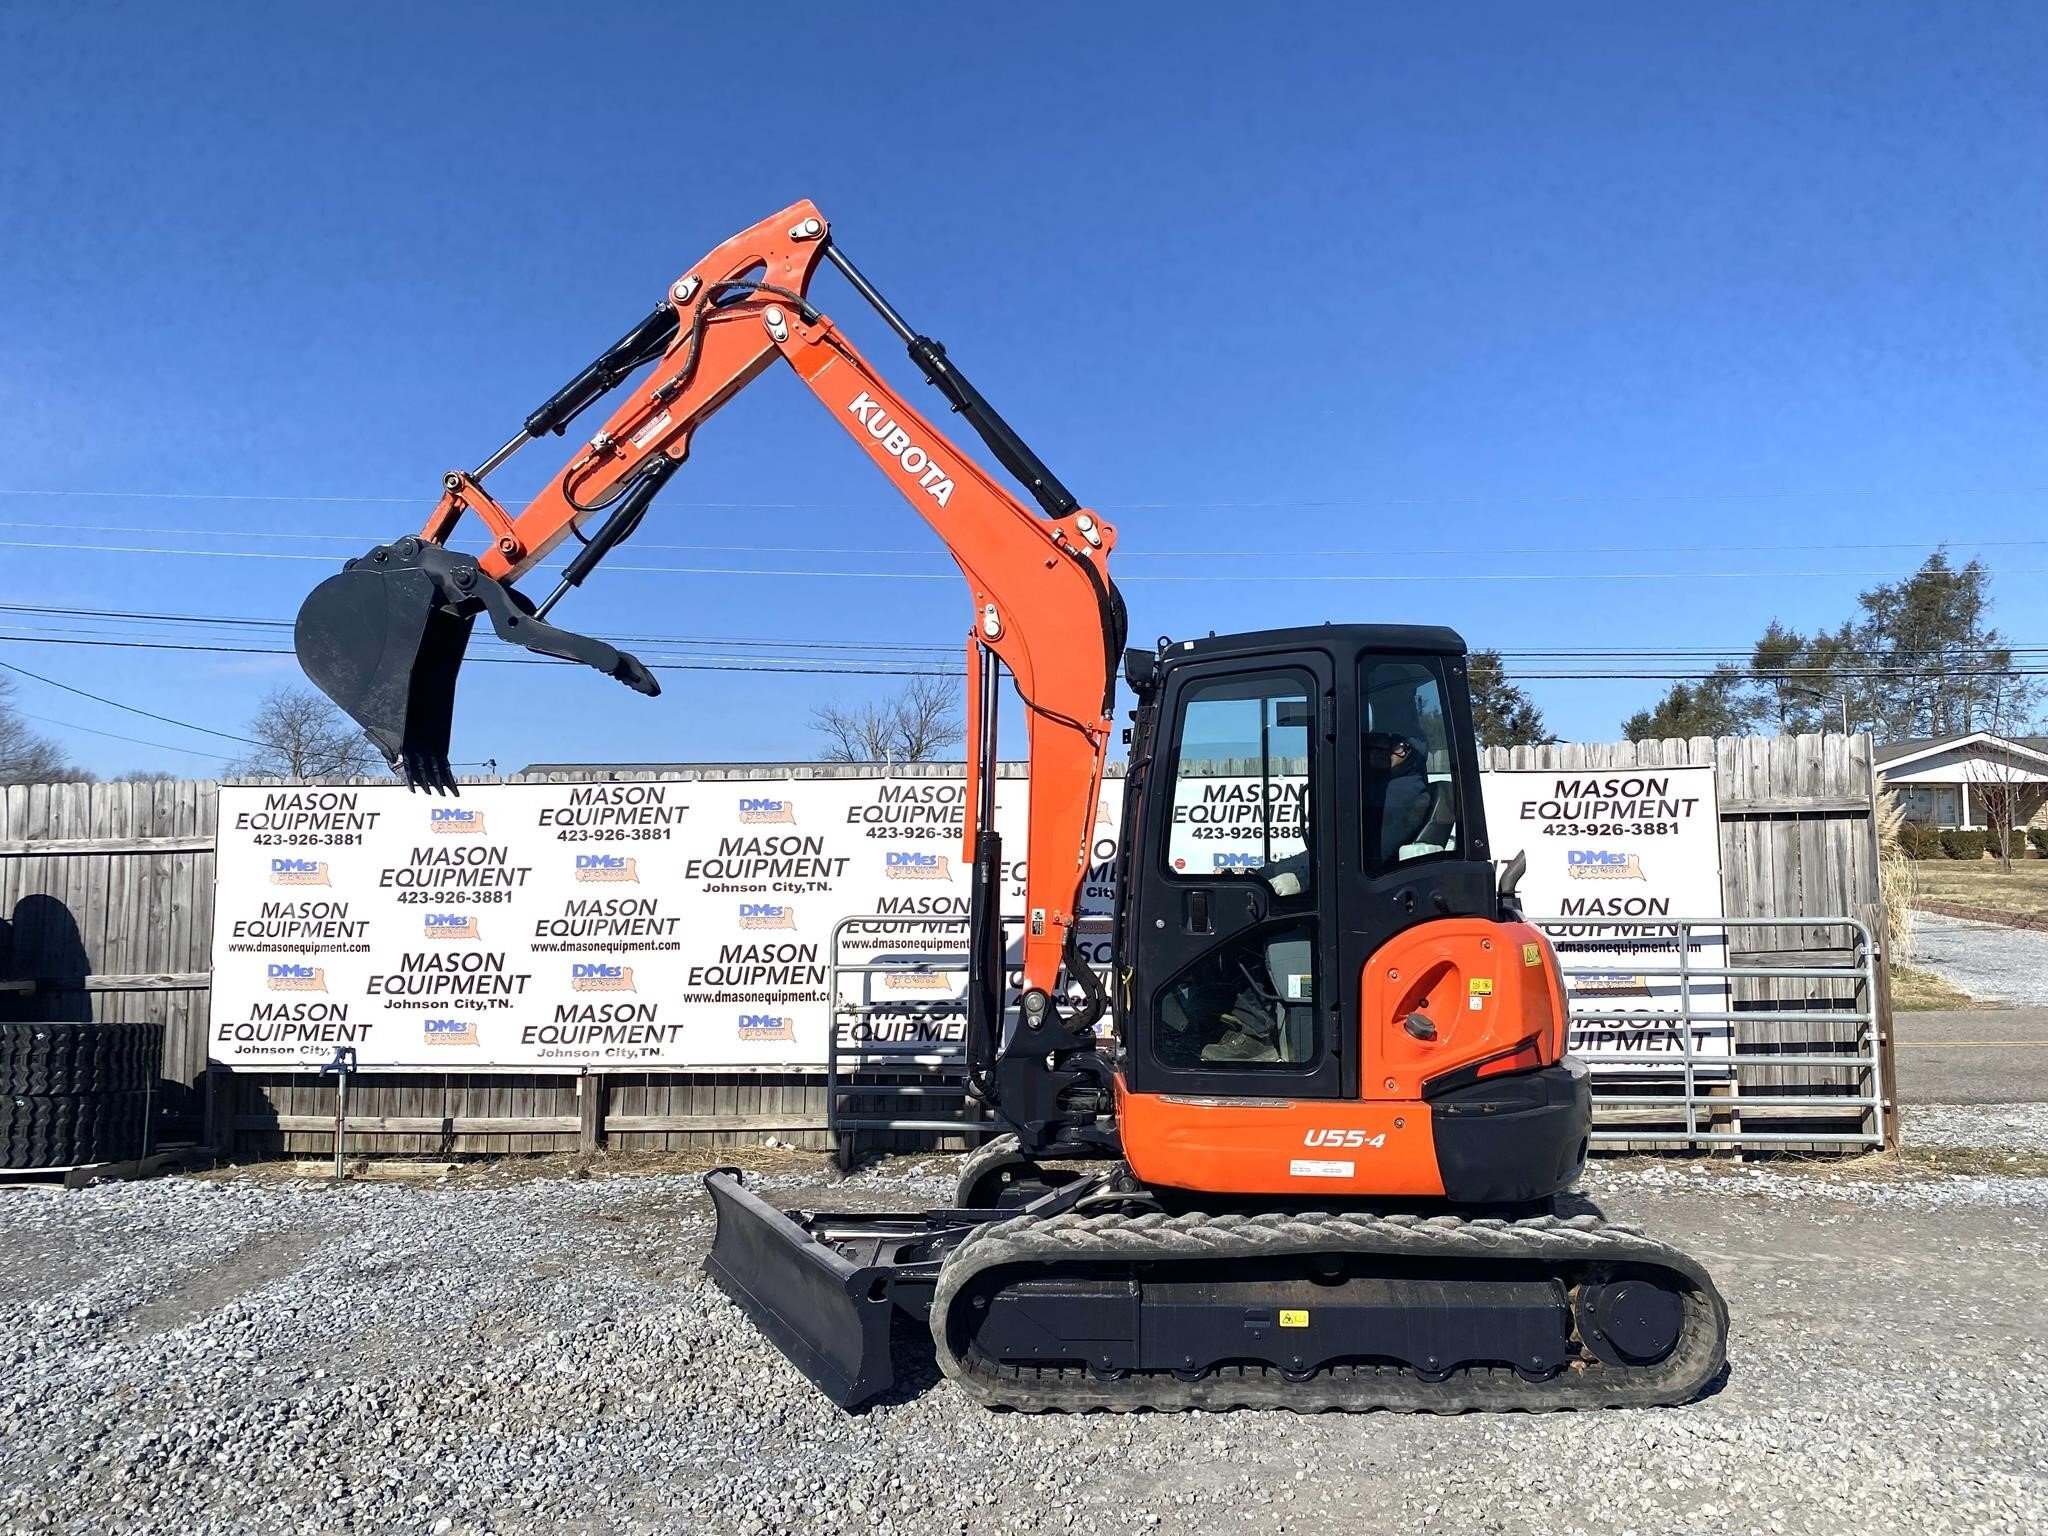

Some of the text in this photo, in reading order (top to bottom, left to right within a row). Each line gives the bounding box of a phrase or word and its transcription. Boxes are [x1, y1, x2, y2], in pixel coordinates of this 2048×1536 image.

[848, 390, 955, 508] KUBOTA
[570, 785, 666, 805] MASON
[1555, 778, 1669, 798] MASON
[265, 793, 358, 810] MASON
[1520, 797, 1700, 819] EQUIPMENT
[236, 813, 381, 830] EQUIPMENT
[539, 807, 690, 826] EQUIPMENT
[847, 805, 1002, 824] EQUIPME
[557, 829, 671, 841] 423-926-3881
[866, 827, 963, 839] 423-926-38
[1543, 823, 1679, 836] 423-926-3881
[254, 834, 362, 845] 423-926-3881
[719, 837, 824, 856] MASON
[411, 847, 508, 865] MASON
[685, 858, 851, 878] EQUIPMENT
[380, 868, 533, 887] EQUIPMENT
[703, 882, 833, 893] Johnson City,TN.
[398, 891, 512, 903] 423-926-3881
[876, 897, 971, 914] MASON
[261, 903, 349, 919] MASON
[565, 899, 658, 916] MASON
[1561, 898, 1670, 916] MASON
[233, 921, 370, 937] EQUIPMENT
[535, 918, 681, 936] EQUIPMENT
[229, 942, 371, 954] www.dmasonequipment.com
[531, 940, 681, 953] www.dmasonequipment.com
[842, 938, 970, 951] www.dmasonequipment
[719, 944, 818, 963] MASON
[401, 953, 506, 972] MASON
[367, 975, 532, 994] EQUIPMENT
[687, 965, 832, 987] EQUIPMEN
[384, 999, 514, 1010] Johnson City,TN.
[683, 989, 842, 1005] www.dmasonequipment.c
[250, 1004, 349, 1021] MASON
[555, 1004, 658, 1022] MASON
[218, 1024, 373, 1041] EQUIPMENT
[522, 1025, 684, 1044] EQUIPMENT
[1568, 1031, 1711, 1052] UIPMENT
[537, 1048, 665, 1059] Johnson City,TN.
[1304, 1129, 1387, 1149] U55-4
